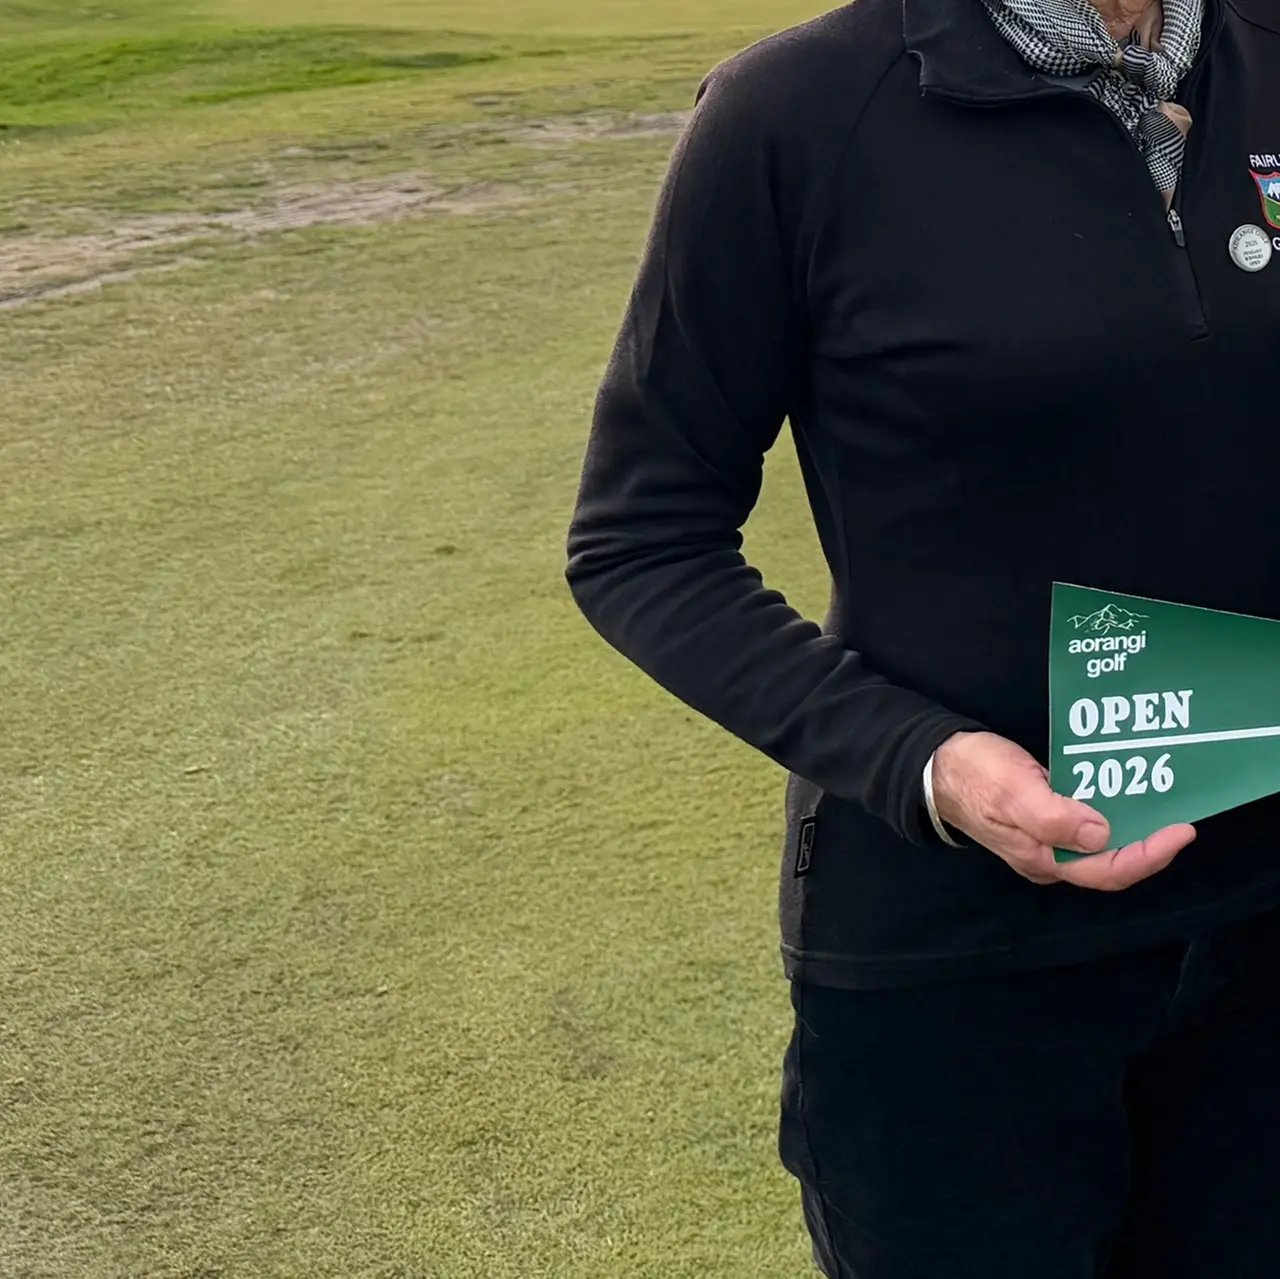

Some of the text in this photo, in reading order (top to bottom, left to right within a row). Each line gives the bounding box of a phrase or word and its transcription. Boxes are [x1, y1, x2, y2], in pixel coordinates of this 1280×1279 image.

[1068, 630, 1147, 654] aorangi
[1086, 652, 1127, 678] golf
[1069, 689, 1193, 737] OPEN
[1071, 753, 1175, 800] 2026
